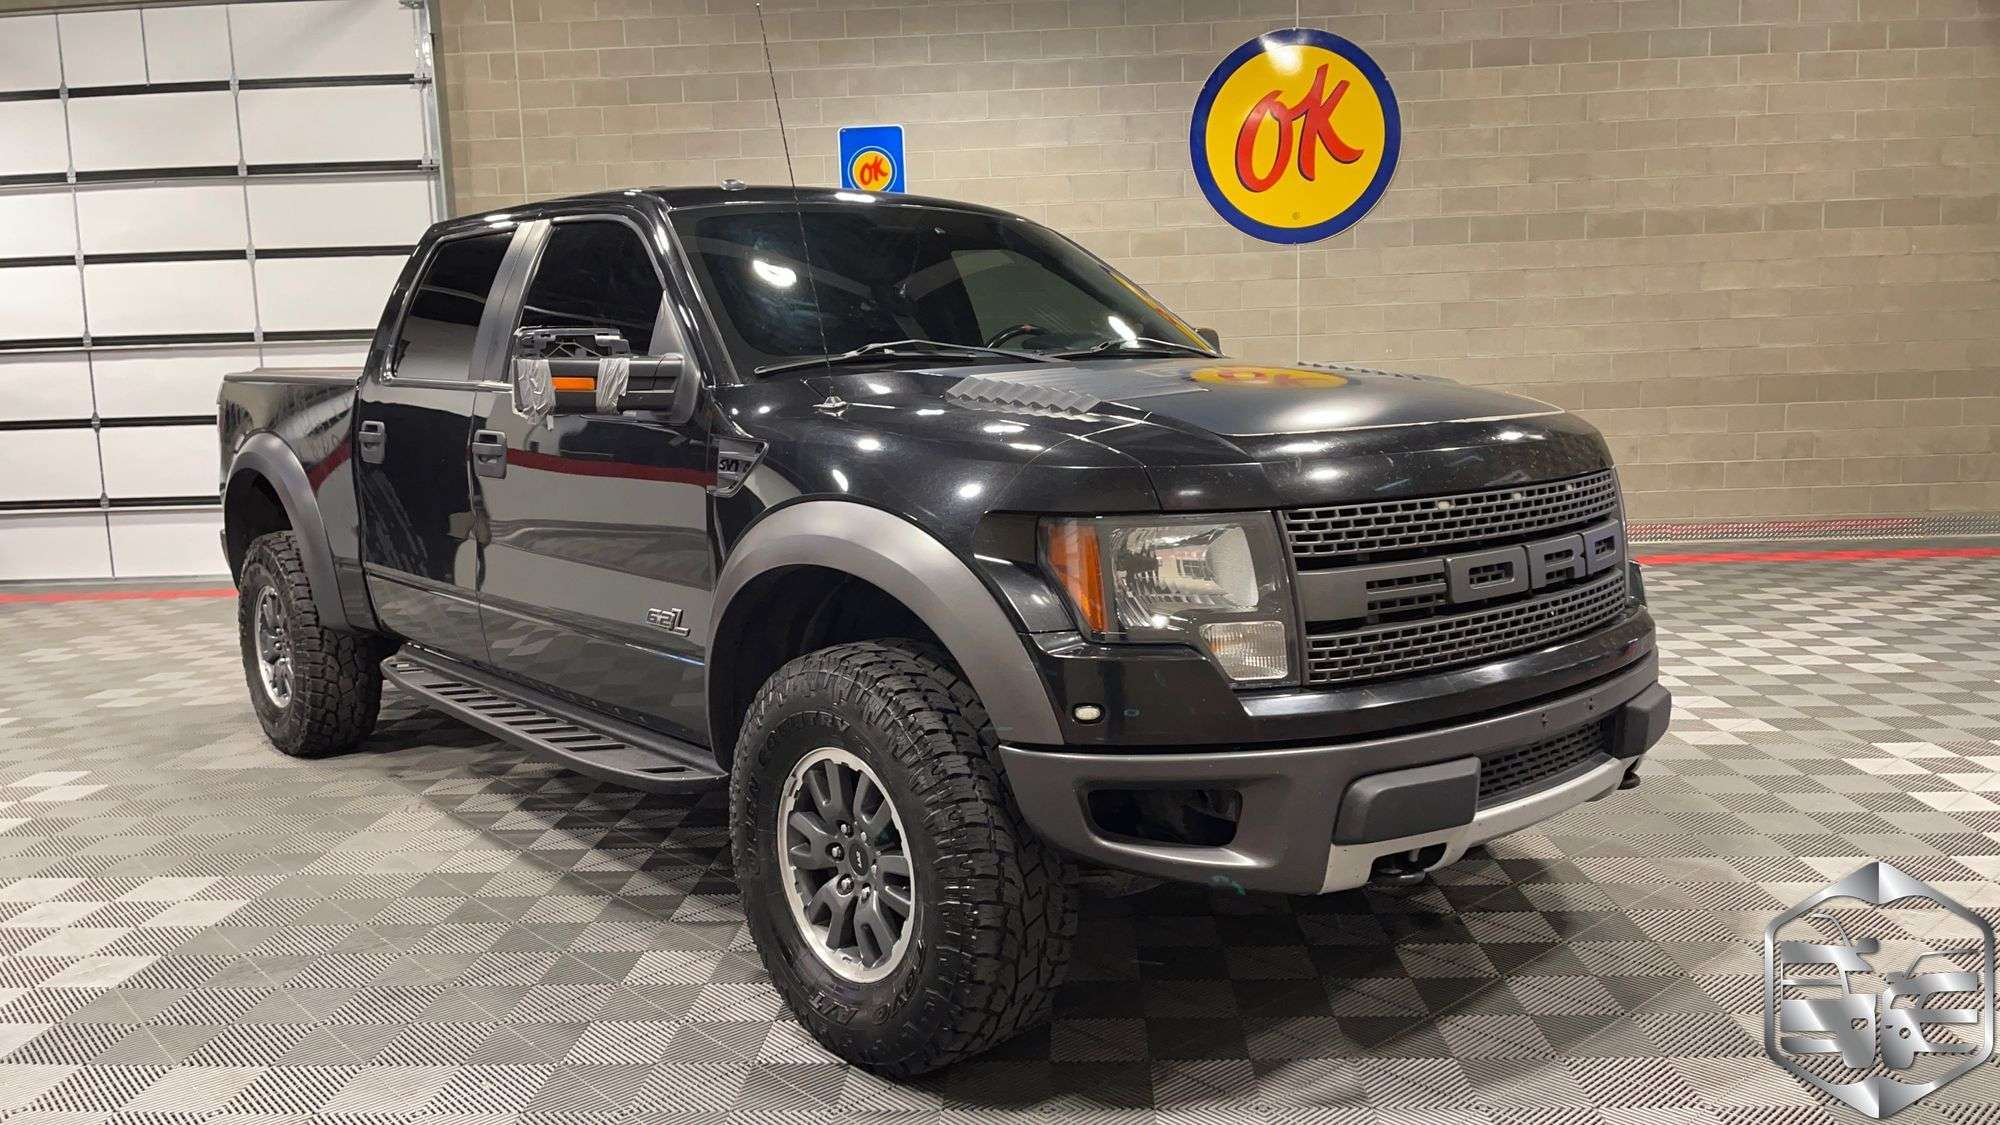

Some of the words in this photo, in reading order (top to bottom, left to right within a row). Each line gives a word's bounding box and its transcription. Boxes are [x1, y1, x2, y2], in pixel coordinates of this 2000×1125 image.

[860, 155, 889, 186] OK
[1235, 63, 1364, 193] OK
[1296, 517, 1620, 622] FORD
